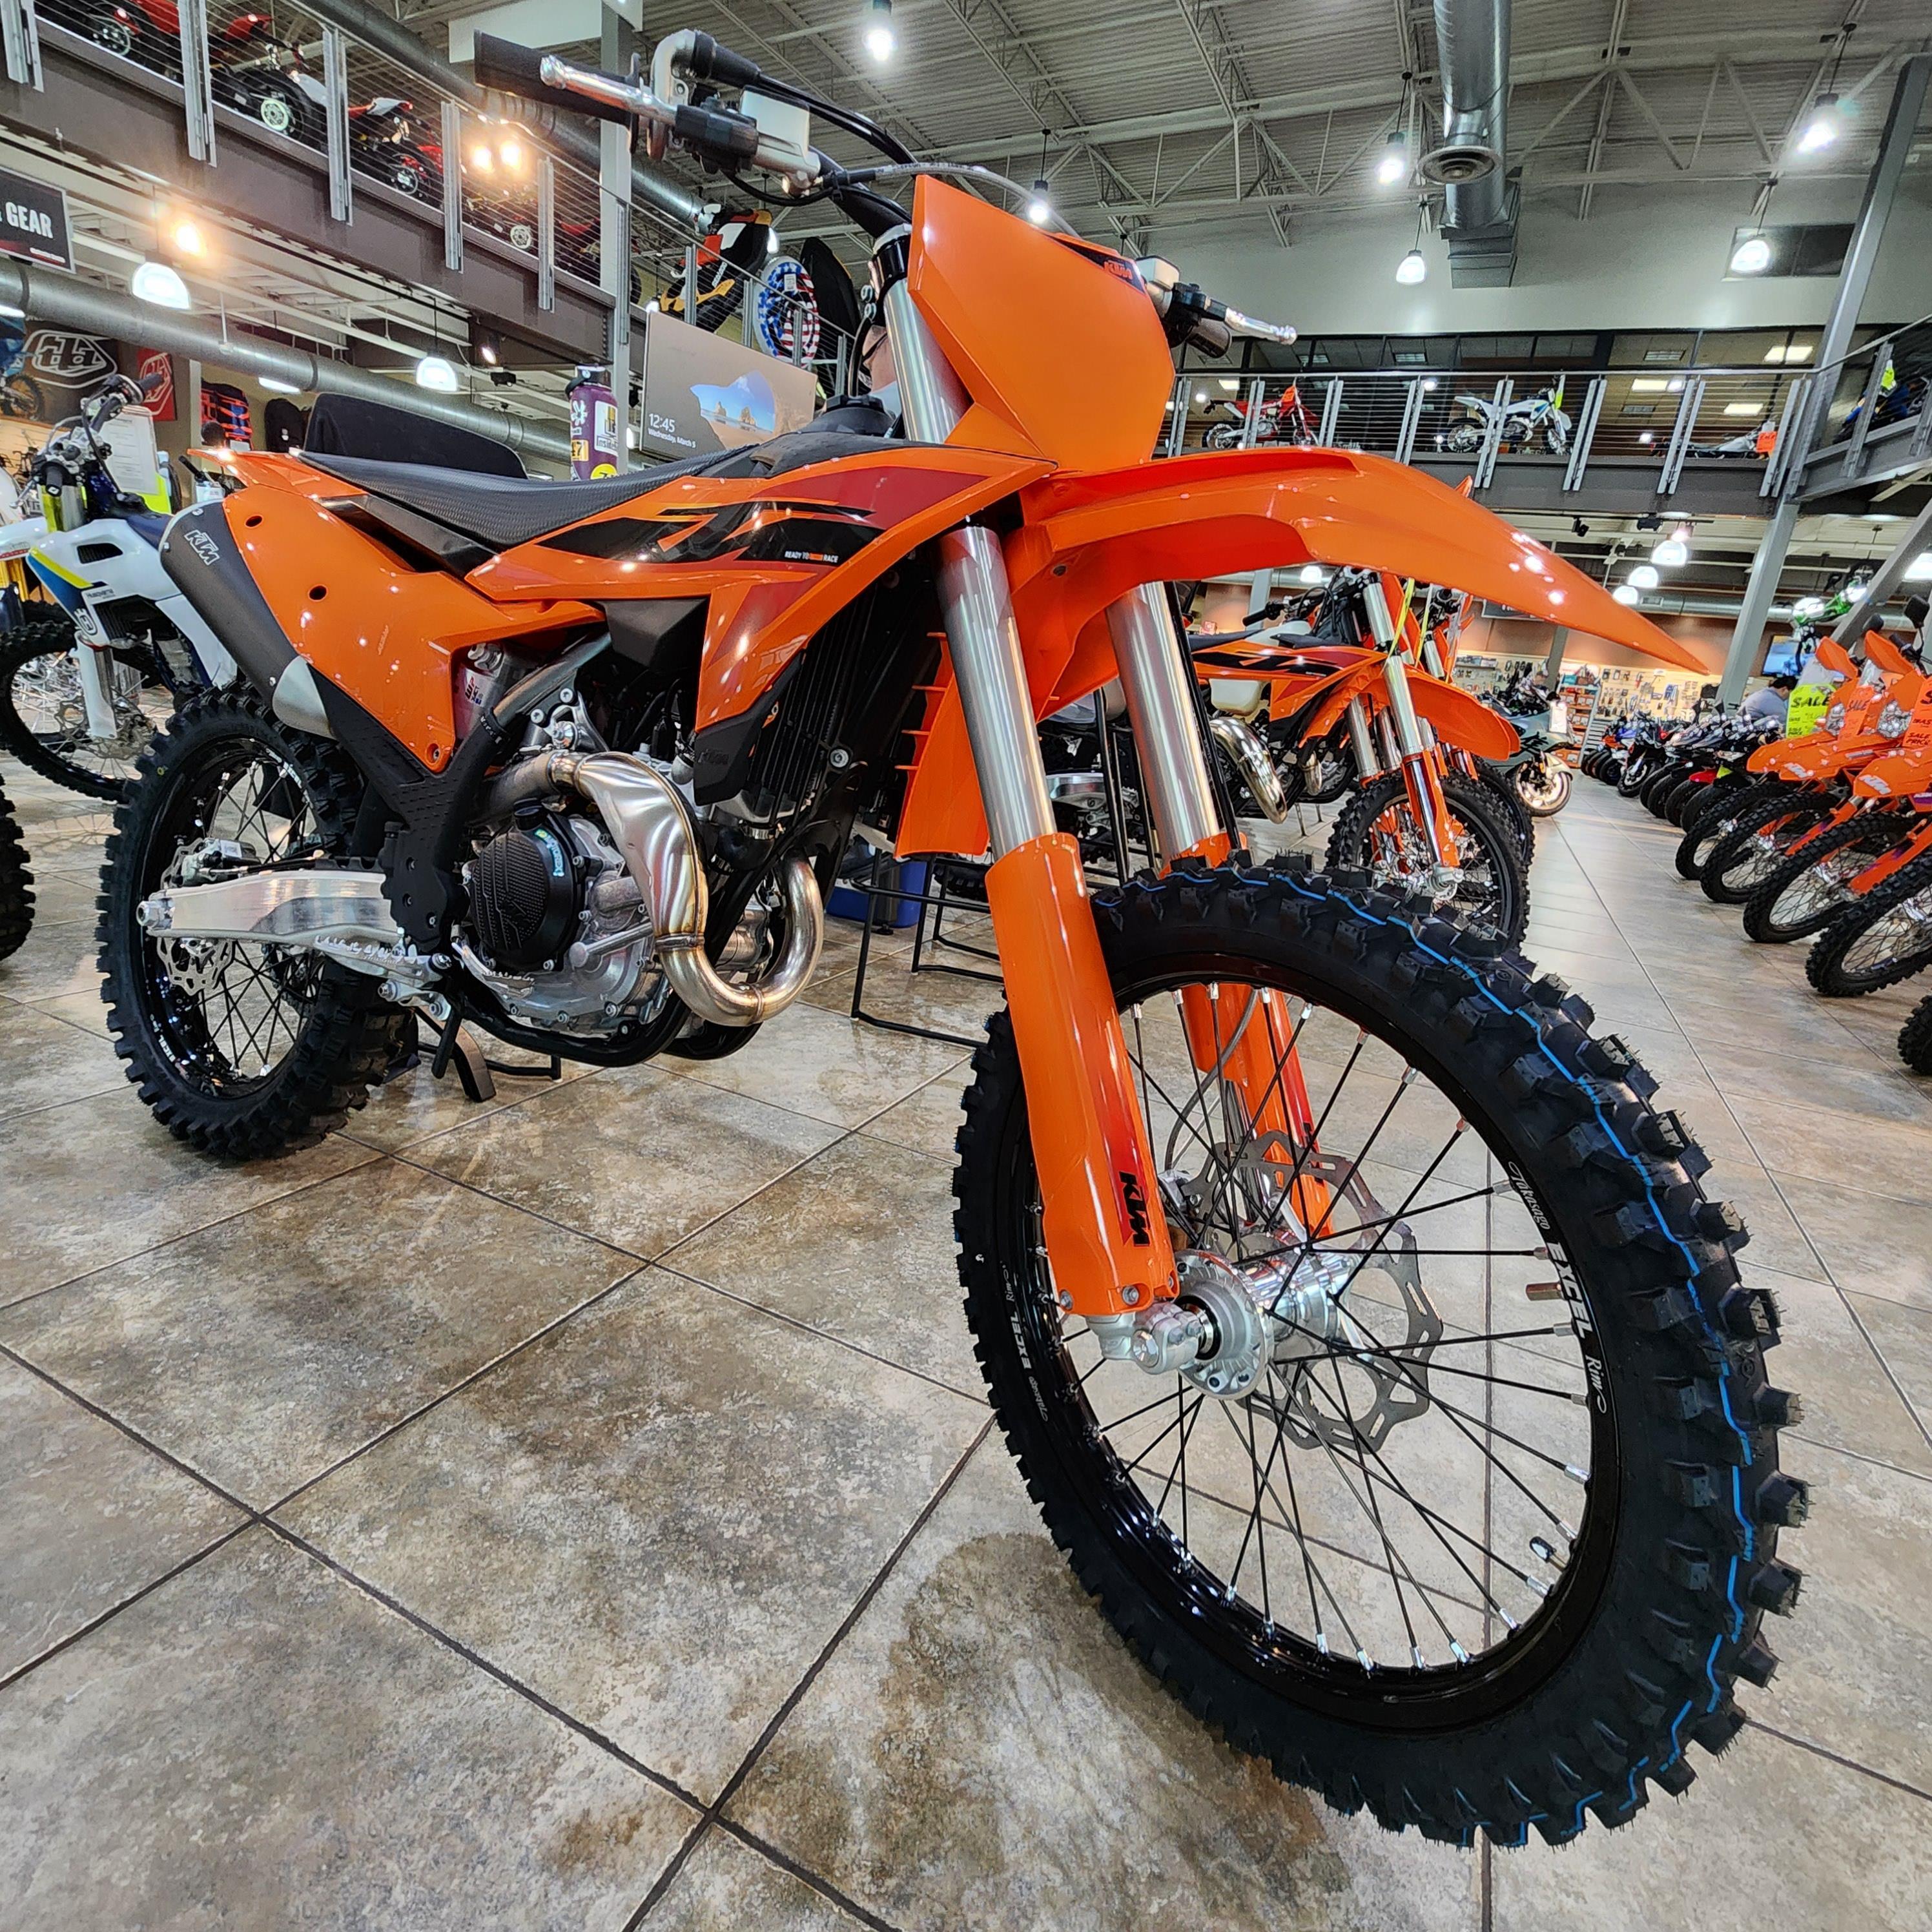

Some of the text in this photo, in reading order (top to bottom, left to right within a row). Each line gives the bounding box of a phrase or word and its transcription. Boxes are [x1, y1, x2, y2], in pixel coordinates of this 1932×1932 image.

[6, 201, 54, 239] GEAR
[649, 413, 675, 433] 12:45
[183, 529, 220, 566] KTM
[785, 551, 801, 559] READY
[823, 553, 839, 563] RACE
[1791, 695, 1830, 708] SALE
[1118, 1170, 1151, 1248] KTM
[1003, 1268, 1015, 1302] Rim
[1508, 1161, 1607, 1414] Takasago EXCEL Rim
[1010, 1310, 1032, 1370] EXCEL
